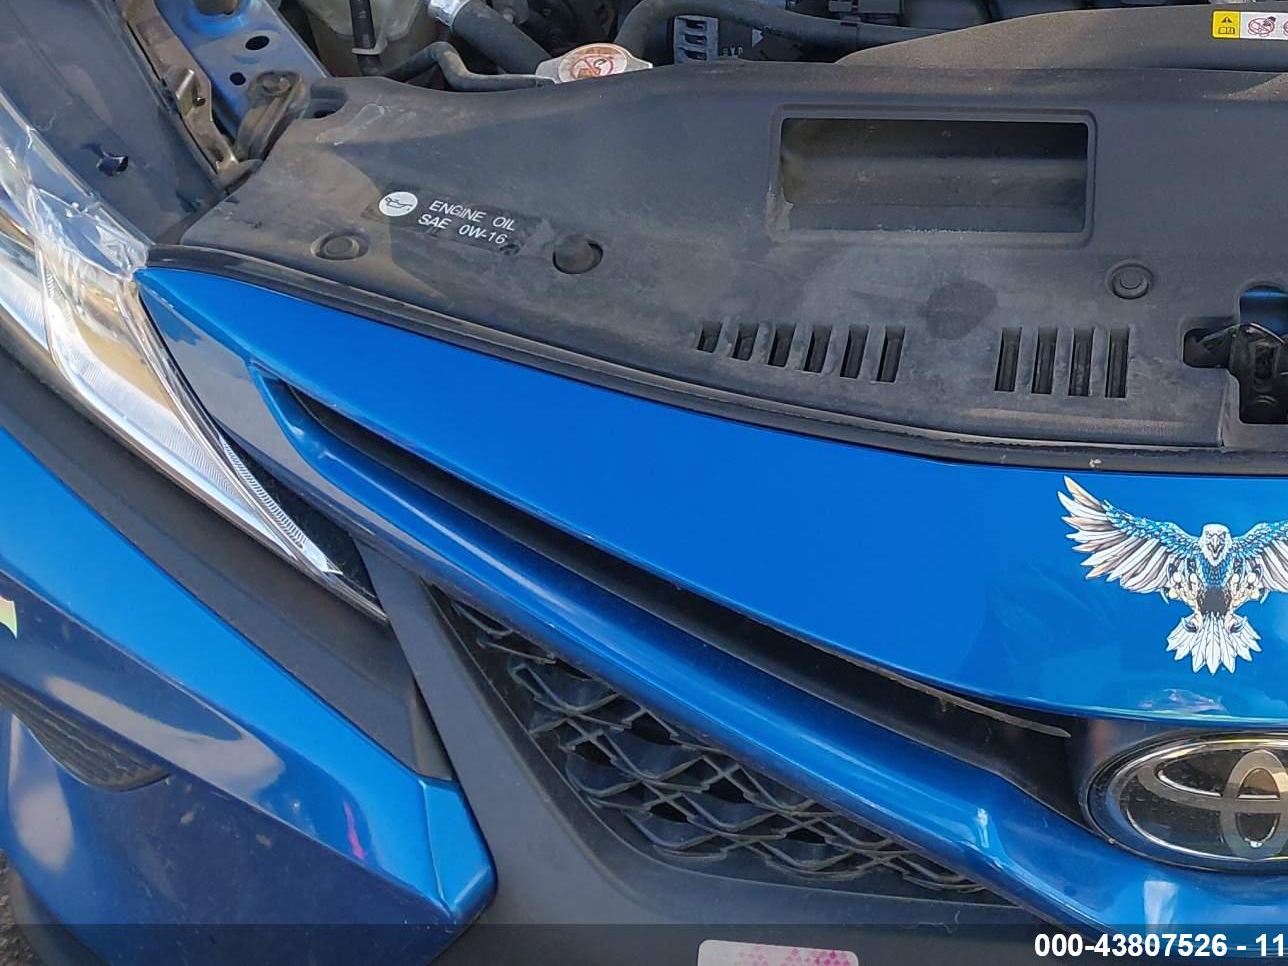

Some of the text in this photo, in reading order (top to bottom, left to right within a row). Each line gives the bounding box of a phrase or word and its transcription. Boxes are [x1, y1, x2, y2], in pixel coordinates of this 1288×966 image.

[418, 214, 508, 245] SAE 0W-16
[429, 200, 516, 232] ENGINE OIL
